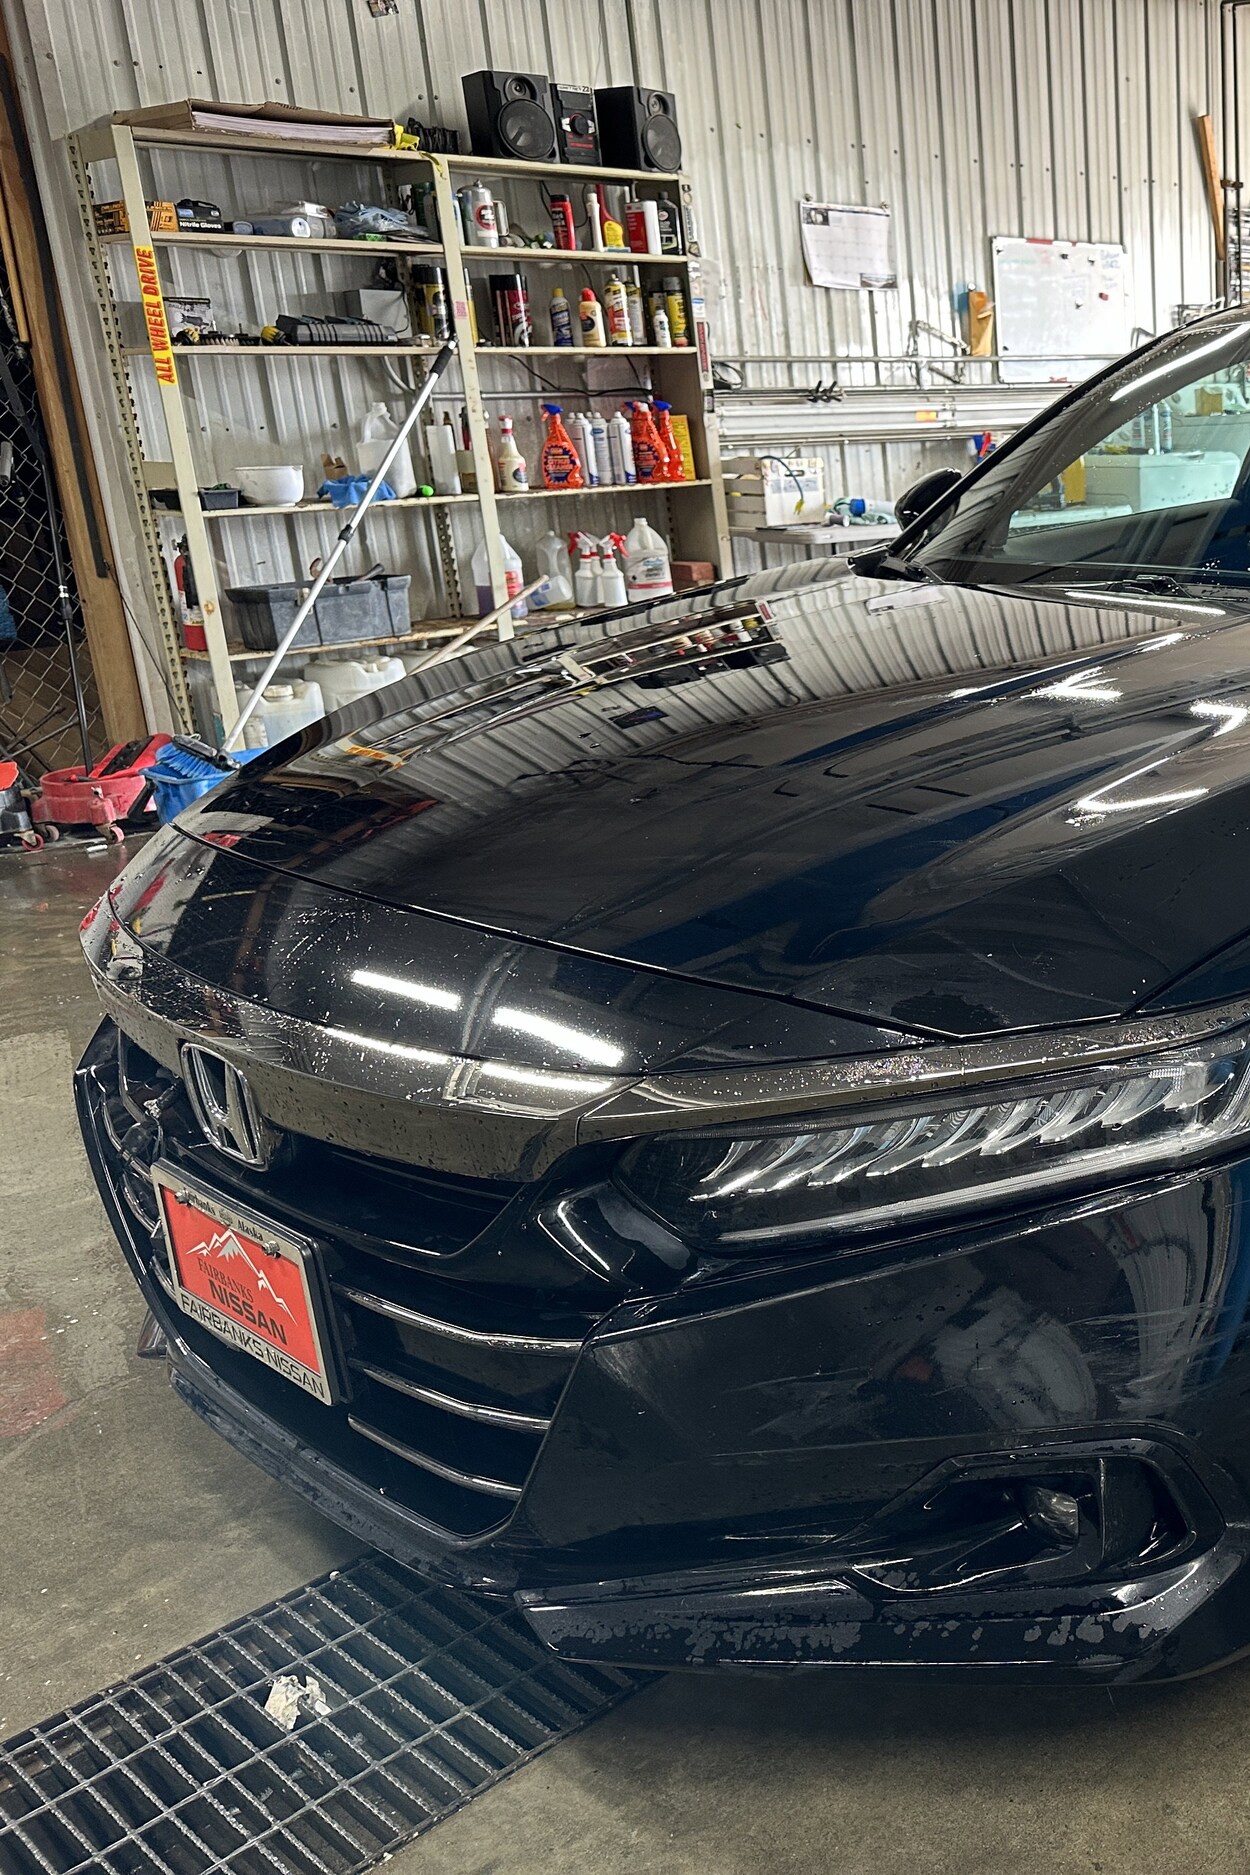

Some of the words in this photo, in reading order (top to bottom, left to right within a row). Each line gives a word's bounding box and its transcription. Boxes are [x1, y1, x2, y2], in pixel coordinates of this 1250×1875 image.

[136, 247, 160, 297] DRIVE
[145, 301, 169, 352] WHEEL
[155, 357, 175, 384] ALL
[237, 1219, 264, 1242] Alaska
[198, 1257, 254, 1304] FAIRBANKS
[209, 1279, 288, 1346] NISSAN
[181, 1293, 265, 1359] FAIRBANKS
[265, 1348, 325, 1400] NISSAN
